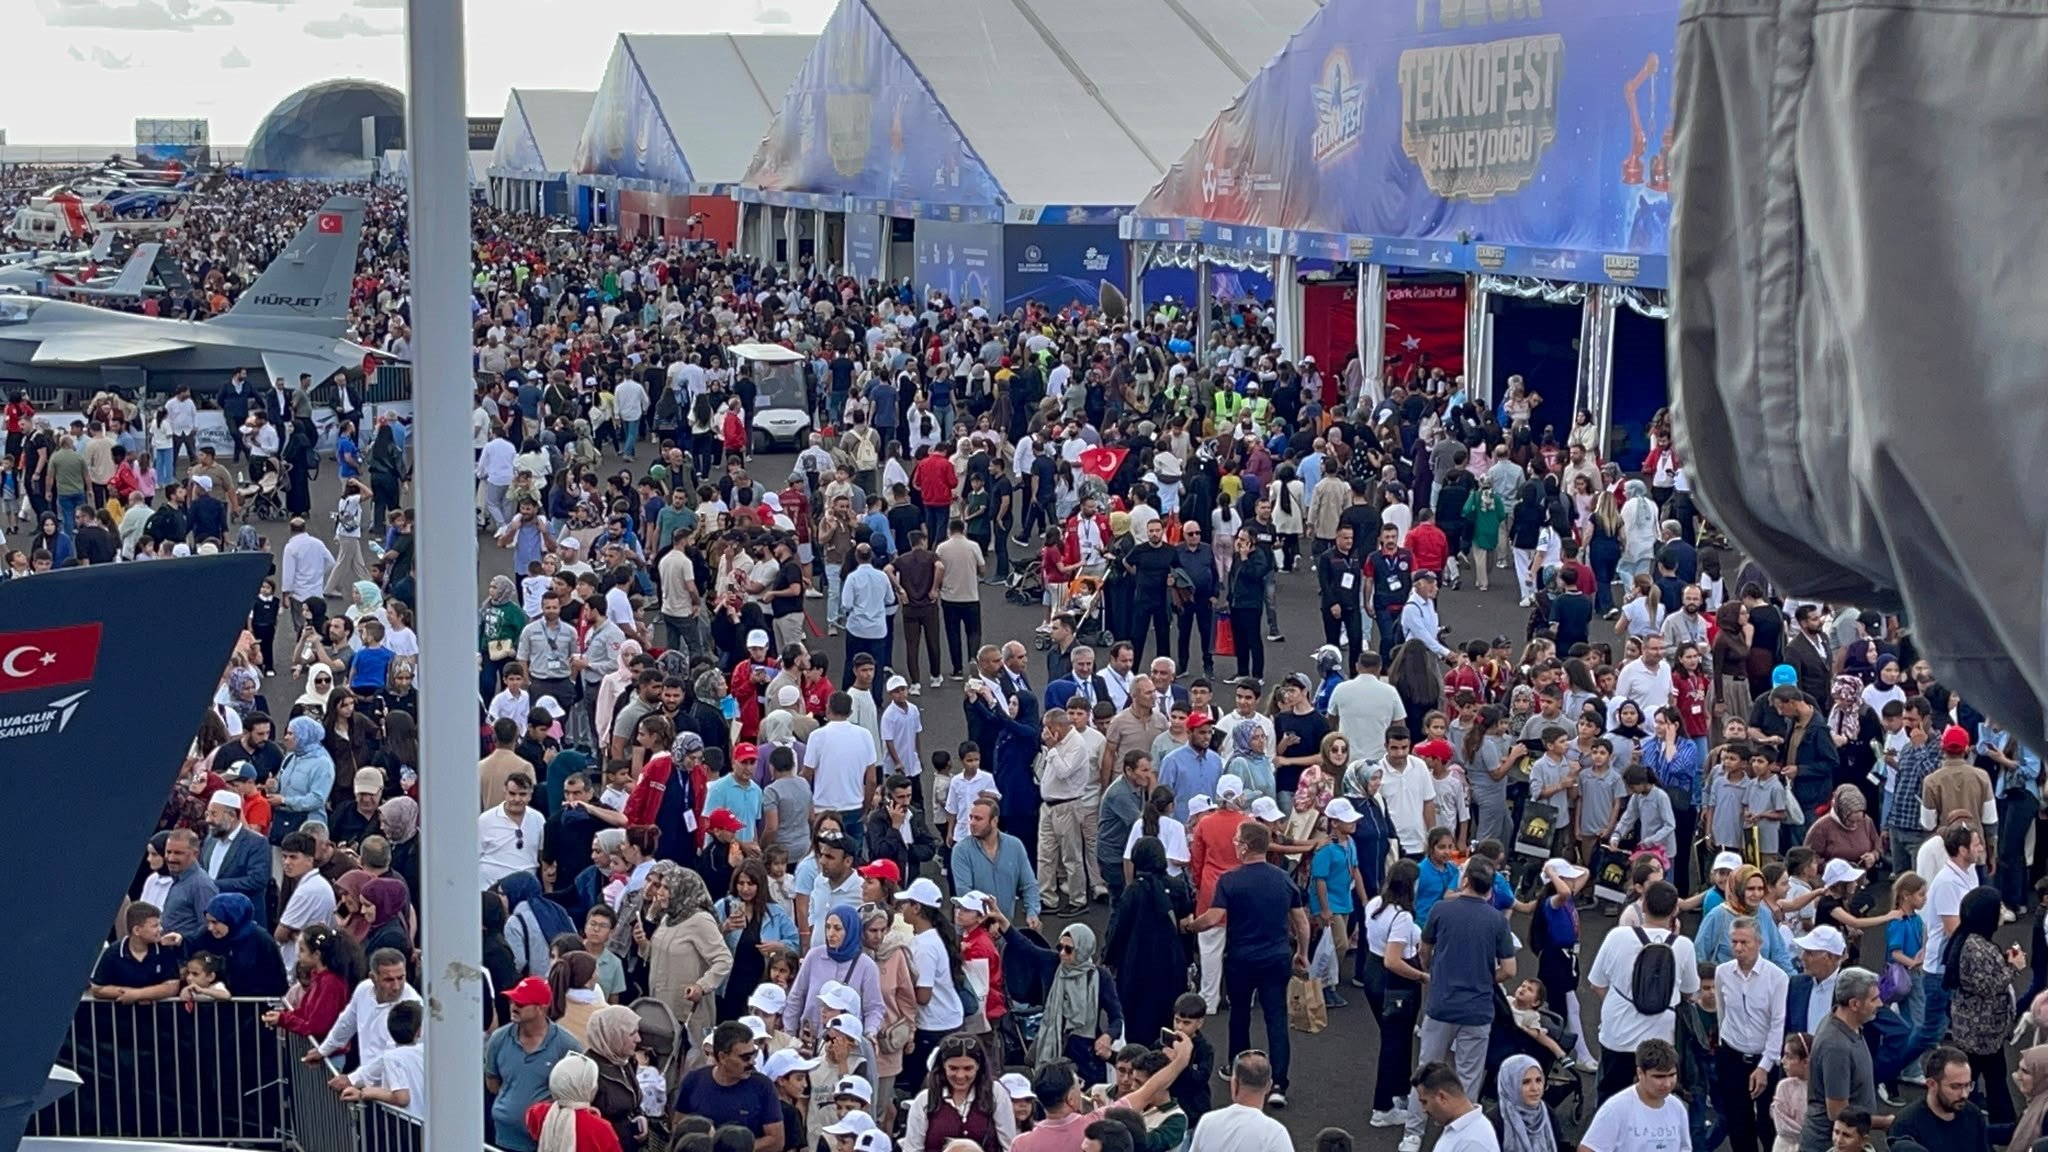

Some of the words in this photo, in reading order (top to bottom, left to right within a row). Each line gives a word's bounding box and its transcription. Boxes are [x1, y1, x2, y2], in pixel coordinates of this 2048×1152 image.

[1401, 46, 1560, 124] TEKNOFEST
[1430, 120, 1532, 170] GÜNEYDOĞU
[254, 293, 321, 307] HÜRJET
[0, 710, 57, 727] VACILIK
